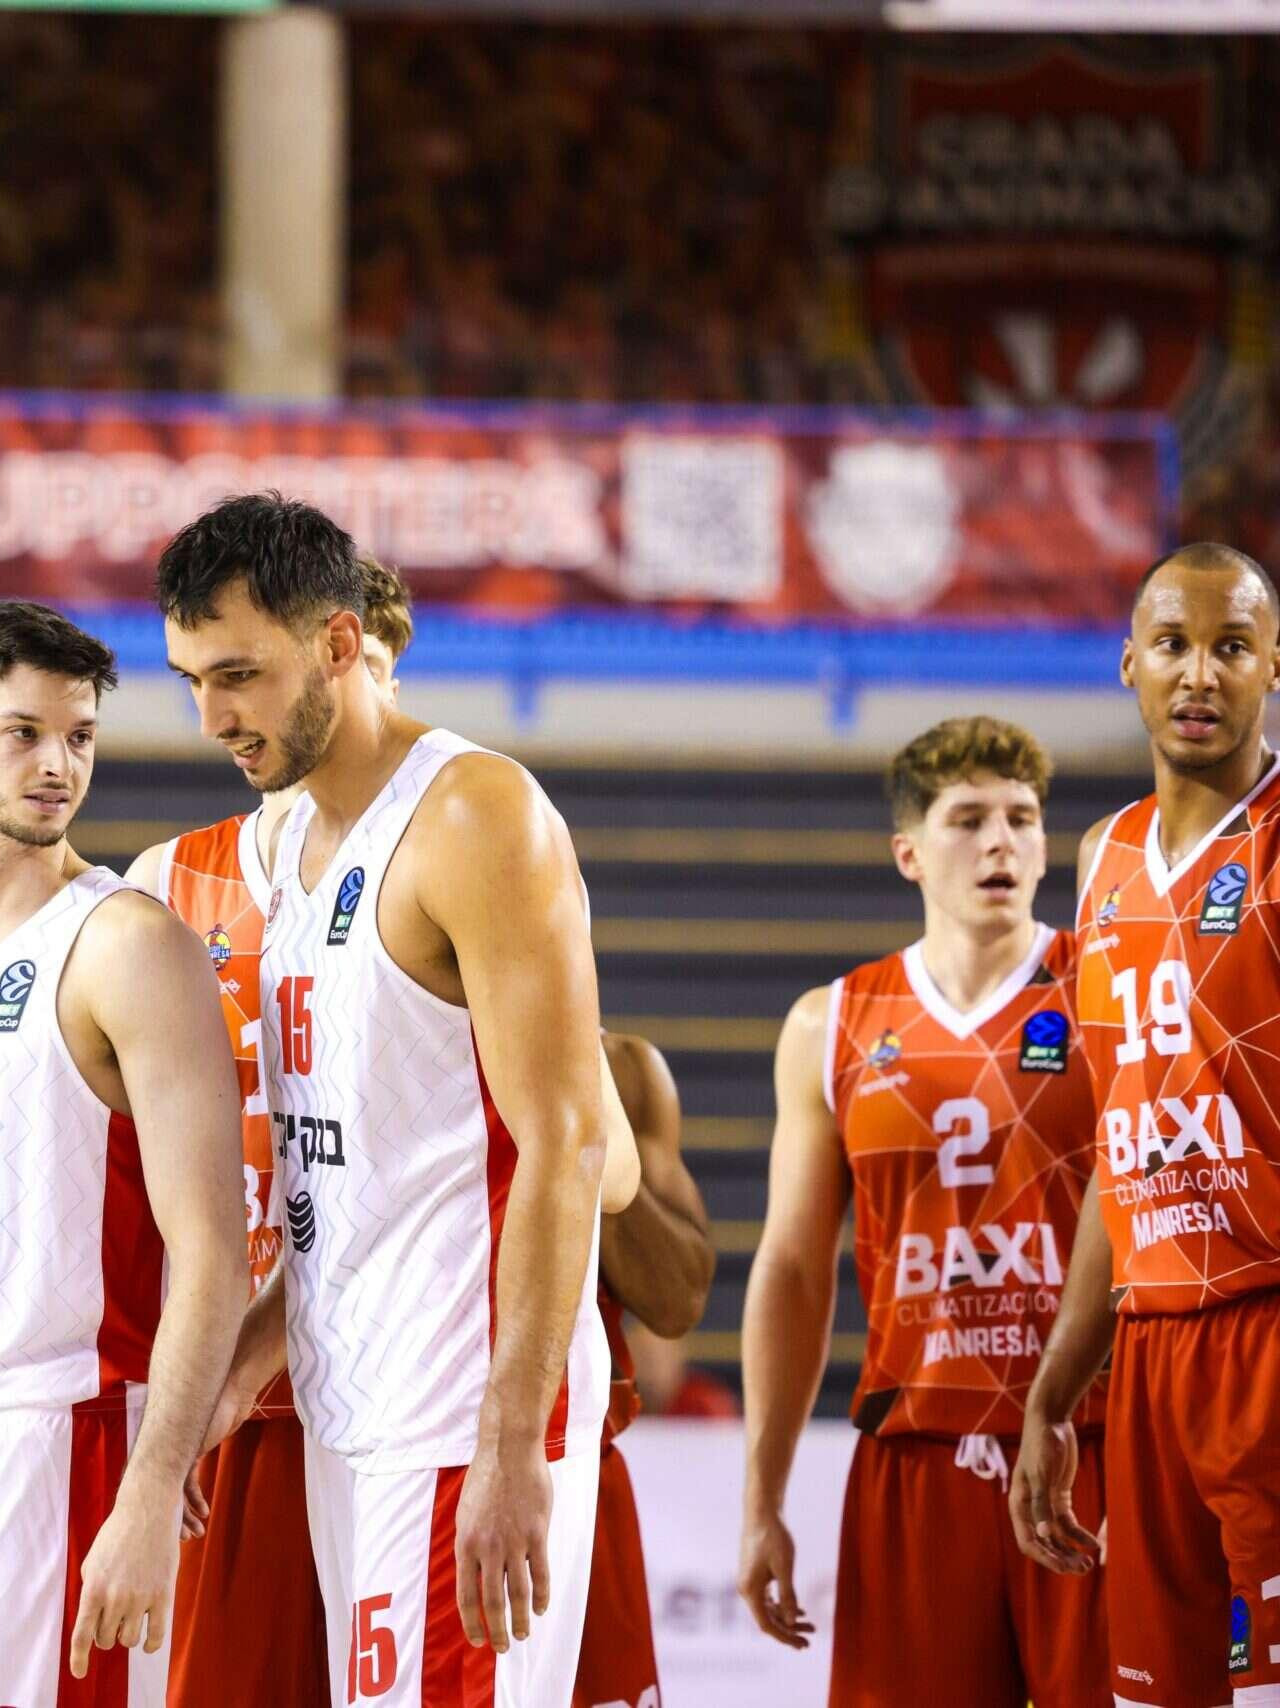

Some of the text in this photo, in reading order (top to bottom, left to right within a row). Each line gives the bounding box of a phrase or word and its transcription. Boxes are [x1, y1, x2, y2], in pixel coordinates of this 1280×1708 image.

[1200, 920, 1238, 931] EuroCup
[276, 975, 316, 1077] 15
[1111, 959, 1193, 1065] 19
[932, 1097, 994, 1188] 2
[1105, 1094, 1244, 1177] BAXI
[896, 1222, 1064, 1298] BAXI
[348, 1592, 397, 1705] 15
